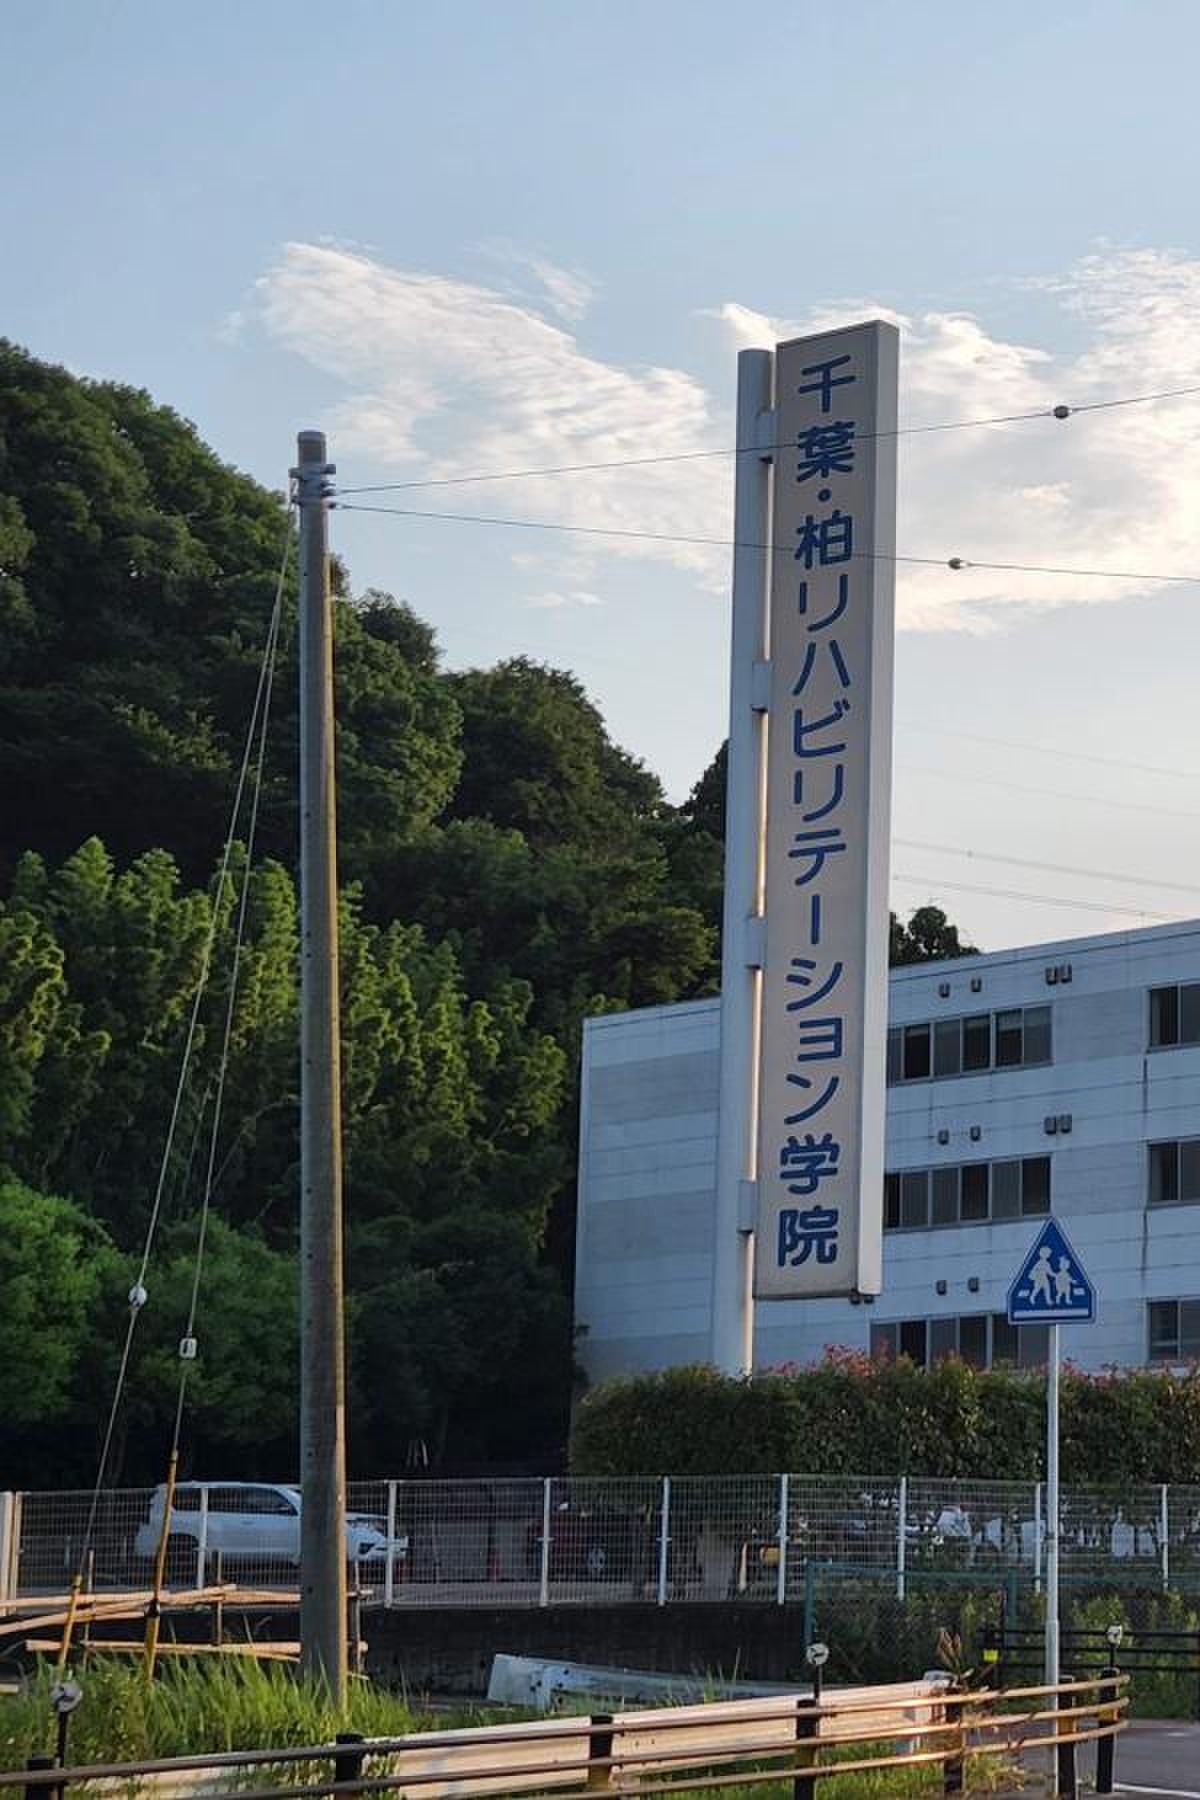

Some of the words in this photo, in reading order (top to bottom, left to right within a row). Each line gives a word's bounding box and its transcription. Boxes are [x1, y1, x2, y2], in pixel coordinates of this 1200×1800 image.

[777, 355, 856, 1266] 千葉・柏リハビリテーション学院
